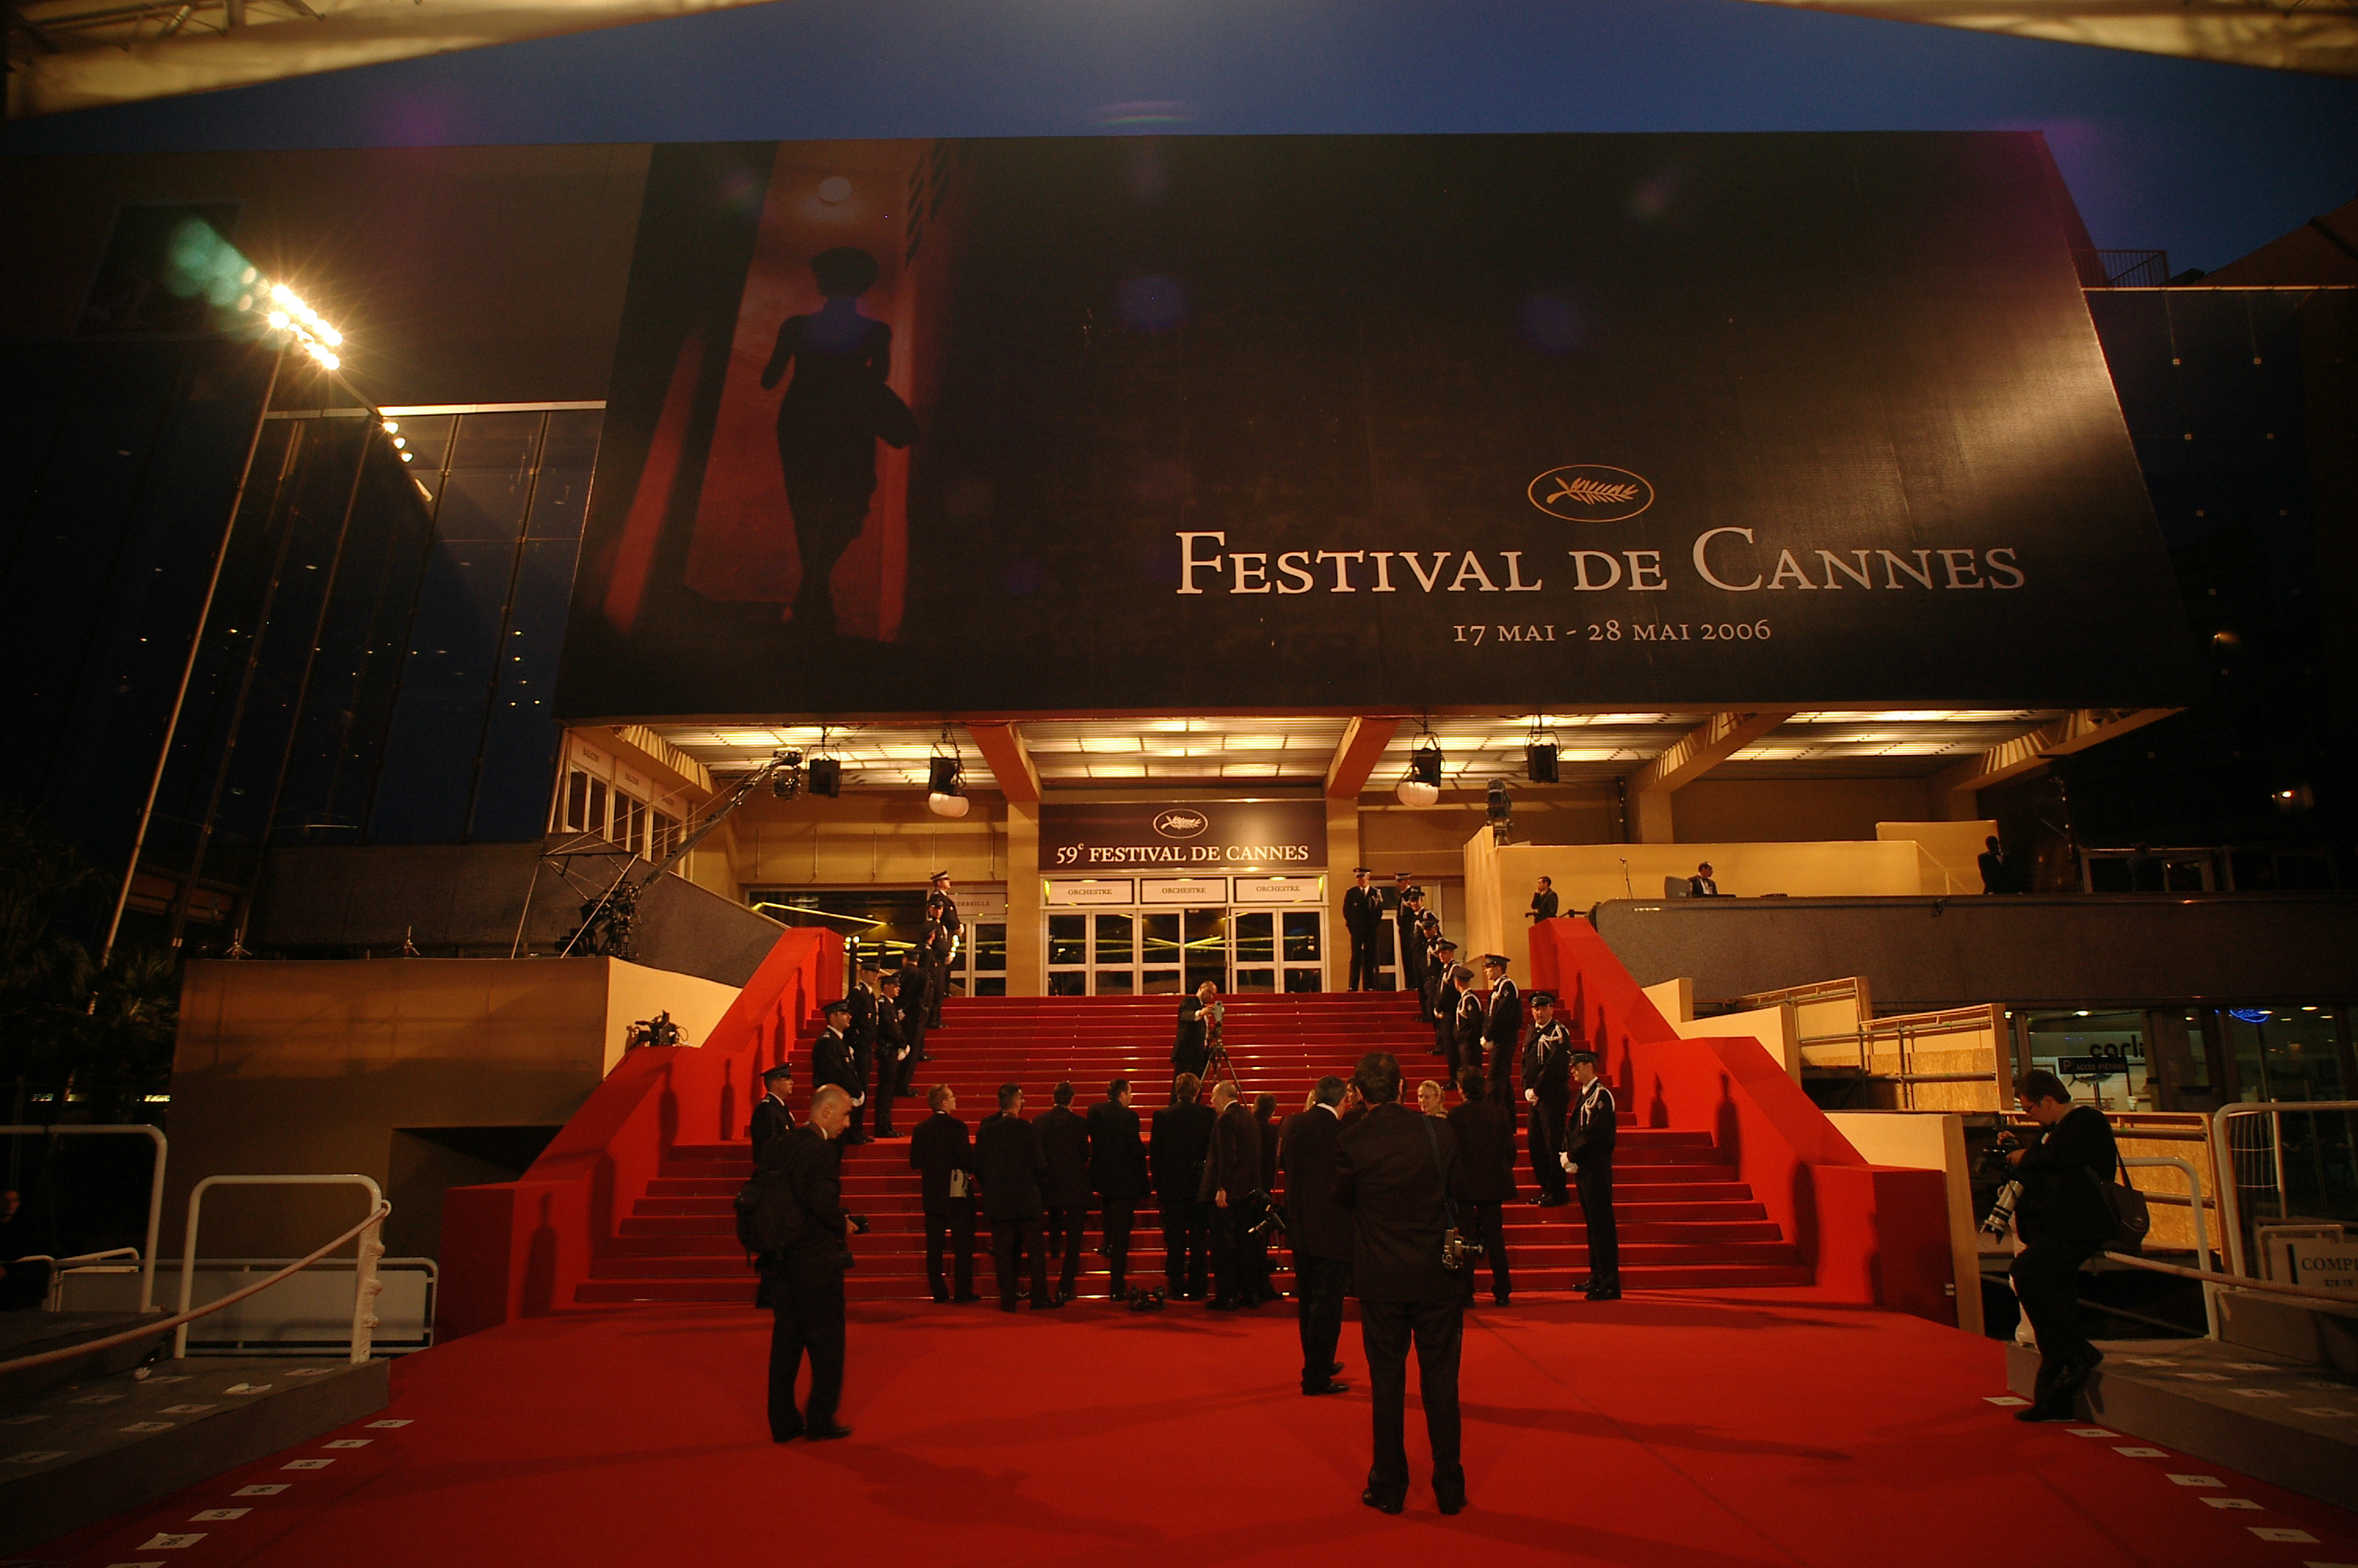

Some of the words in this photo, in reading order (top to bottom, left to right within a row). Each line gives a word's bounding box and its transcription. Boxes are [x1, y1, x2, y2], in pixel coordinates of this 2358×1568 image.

[1175, 531, 1543, 594] FESTIVAL
[1568, 550, 1668, 591] DE
[1693, 527, 2025, 592] CANNES
[1453, 624, 1486, 644] 17
[1498, 625, 1556, 641] MAI
[1587, 619, 1621, 641] 28
[1632, 624, 1690, 640] MAI
[1700, 620, 1771, 640] 2006
[1089, 846, 1187, 862] FESTIVAL
[1190, 846, 1221, 861] DE
[1226, 845, 1309, 861] CANNES
